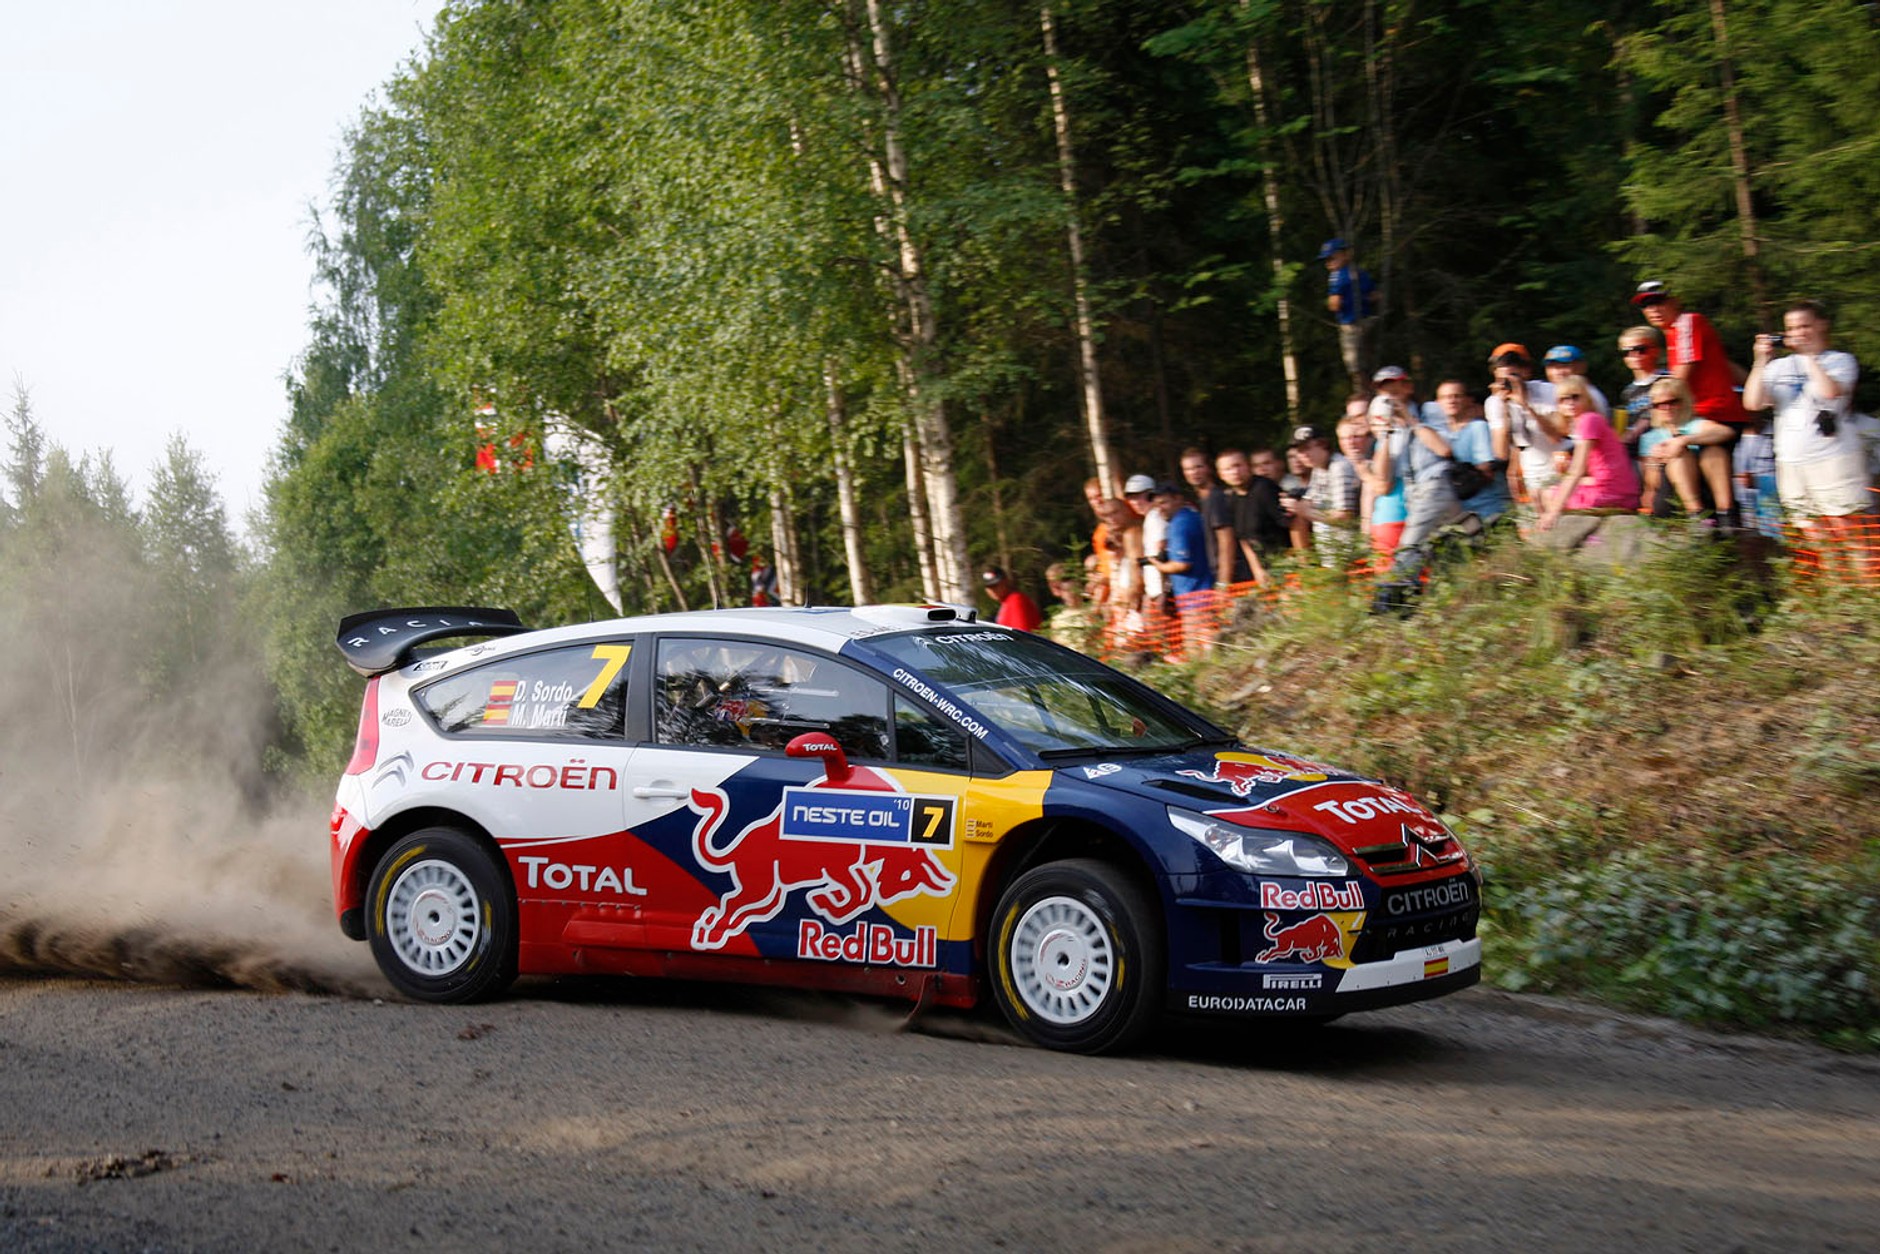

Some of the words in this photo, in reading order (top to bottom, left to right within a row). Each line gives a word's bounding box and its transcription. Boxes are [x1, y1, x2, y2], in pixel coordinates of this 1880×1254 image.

[513, 680, 527, 702] D.
[531, 680, 574, 702] Sordo
[577, 644, 632, 709] 7
[511, 704, 526, 727] M.
[892, 667, 989, 740] CITROEN-WRC.COM
[802, 743, 838, 752] TOTAL
[421, 758, 618, 791] CITROËN
[793, 805, 865, 826] NESTE
[868, 810, 900, 828] OIL
[922, 806, 945, 838] 7
[1313, 793, 1423, 825] TOTAL
[517, 855, 648, 896] TOTAL
[1260, 881, 1319, 910] Red
[1317, 881, 1365, 910] Bull
[1387, 877, 1469, 915] CITROËN
[798, 918, 867, 963] Red
[868, 922, 937, 967] Bull
[1262, 973, 1323, 990] PIRELLI
[1188, 994, 1307, 1012] EURODATACAR
